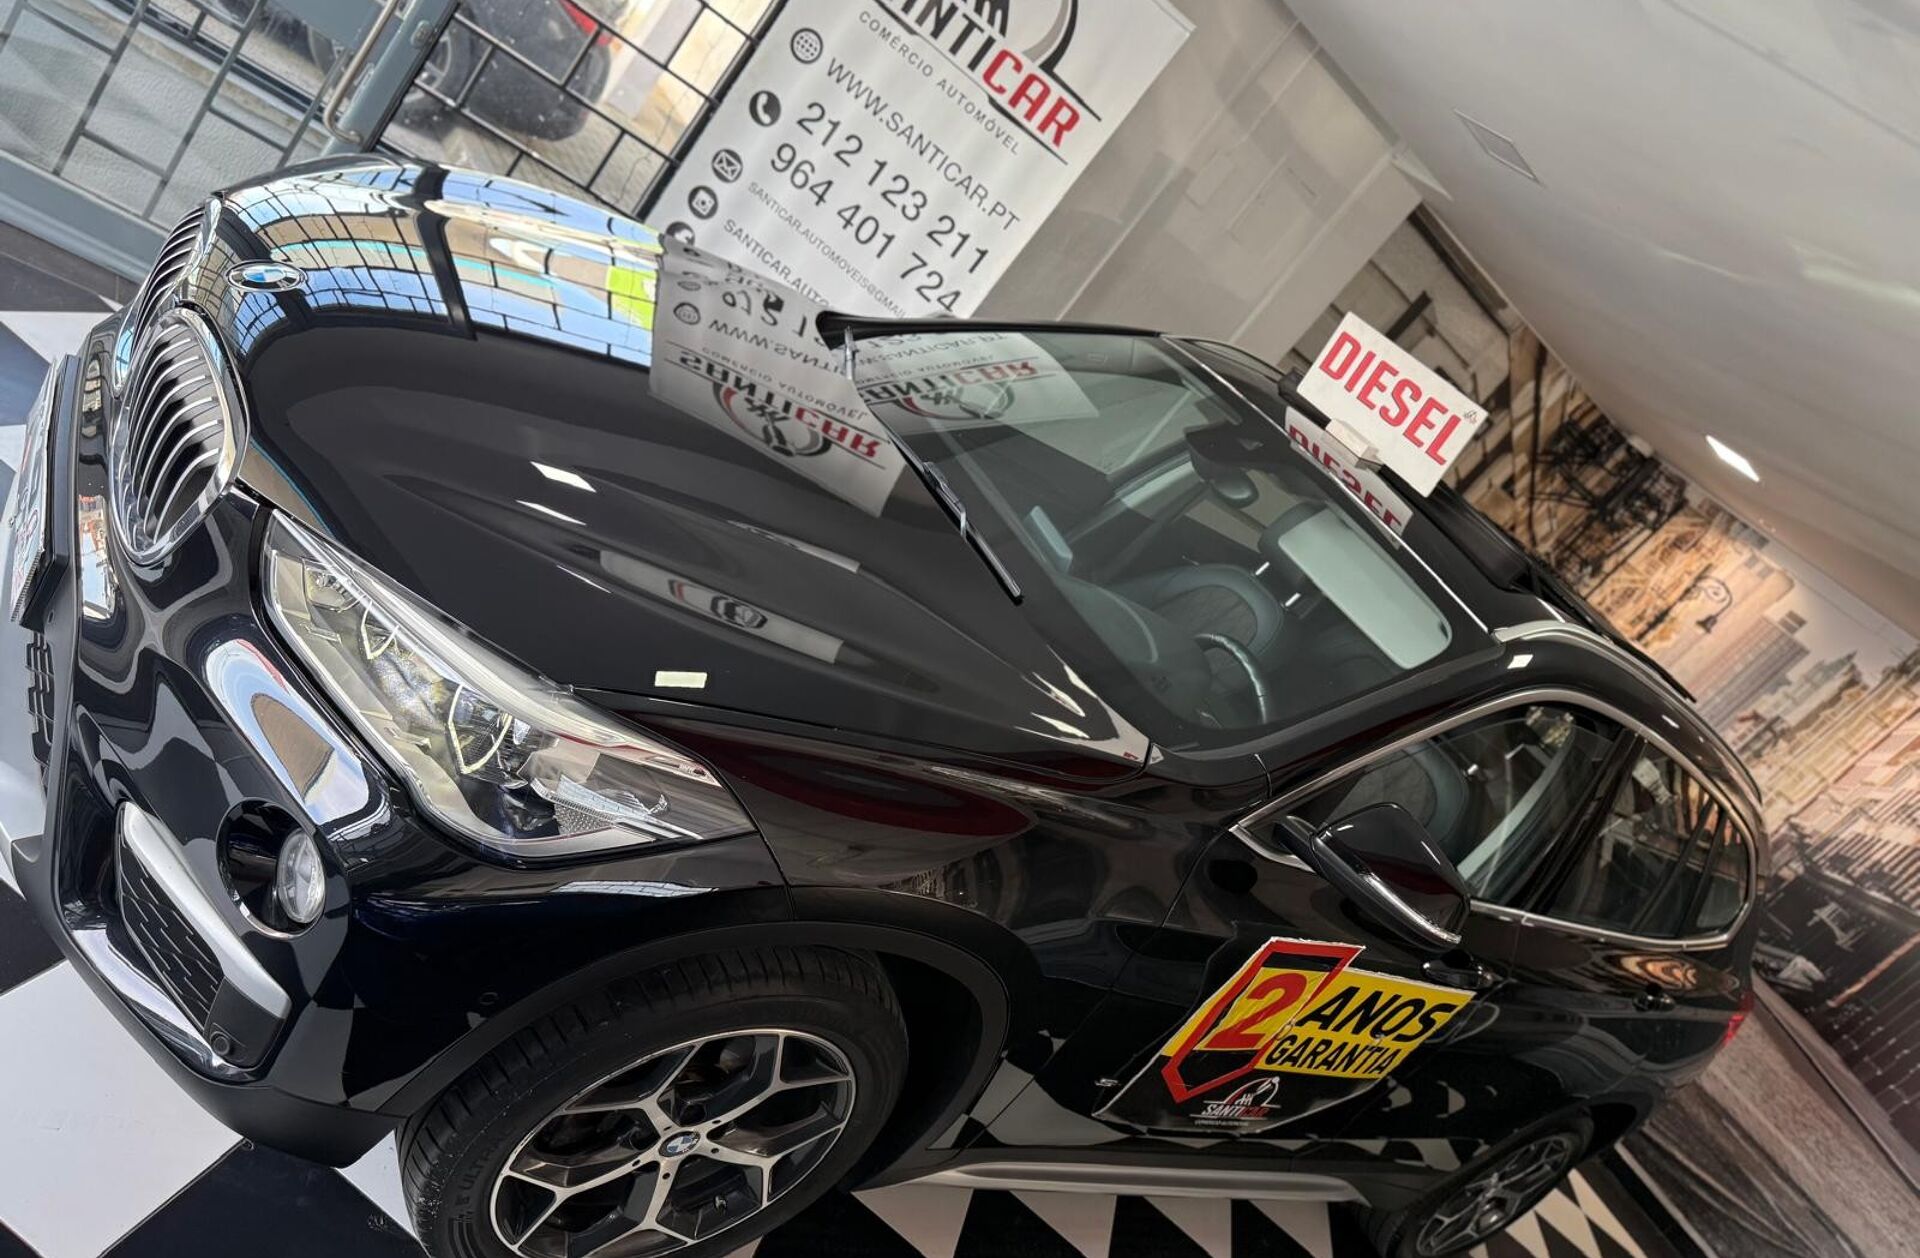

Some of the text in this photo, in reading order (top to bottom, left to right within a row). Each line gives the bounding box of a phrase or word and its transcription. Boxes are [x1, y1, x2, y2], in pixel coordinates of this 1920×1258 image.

[826, 57, 1020, 231] WWW.SANTICAR.PT
[889, 0, 1080, 147] NTICAR
[937, 79, 1019, 155] AUTOMÓVEL
[770, 143, 834, 206] 964
[836, 204, 896, 259] 401
[900, 252, 961, 312] 724
[796, 102, 989, 274] 212 123 211
[1318, 331, 1462, 466] DIESEL
[1206, 973, 1460, 1049] 2 ANOS
[1265, 1034, 1403, 1075] GARANTIA
